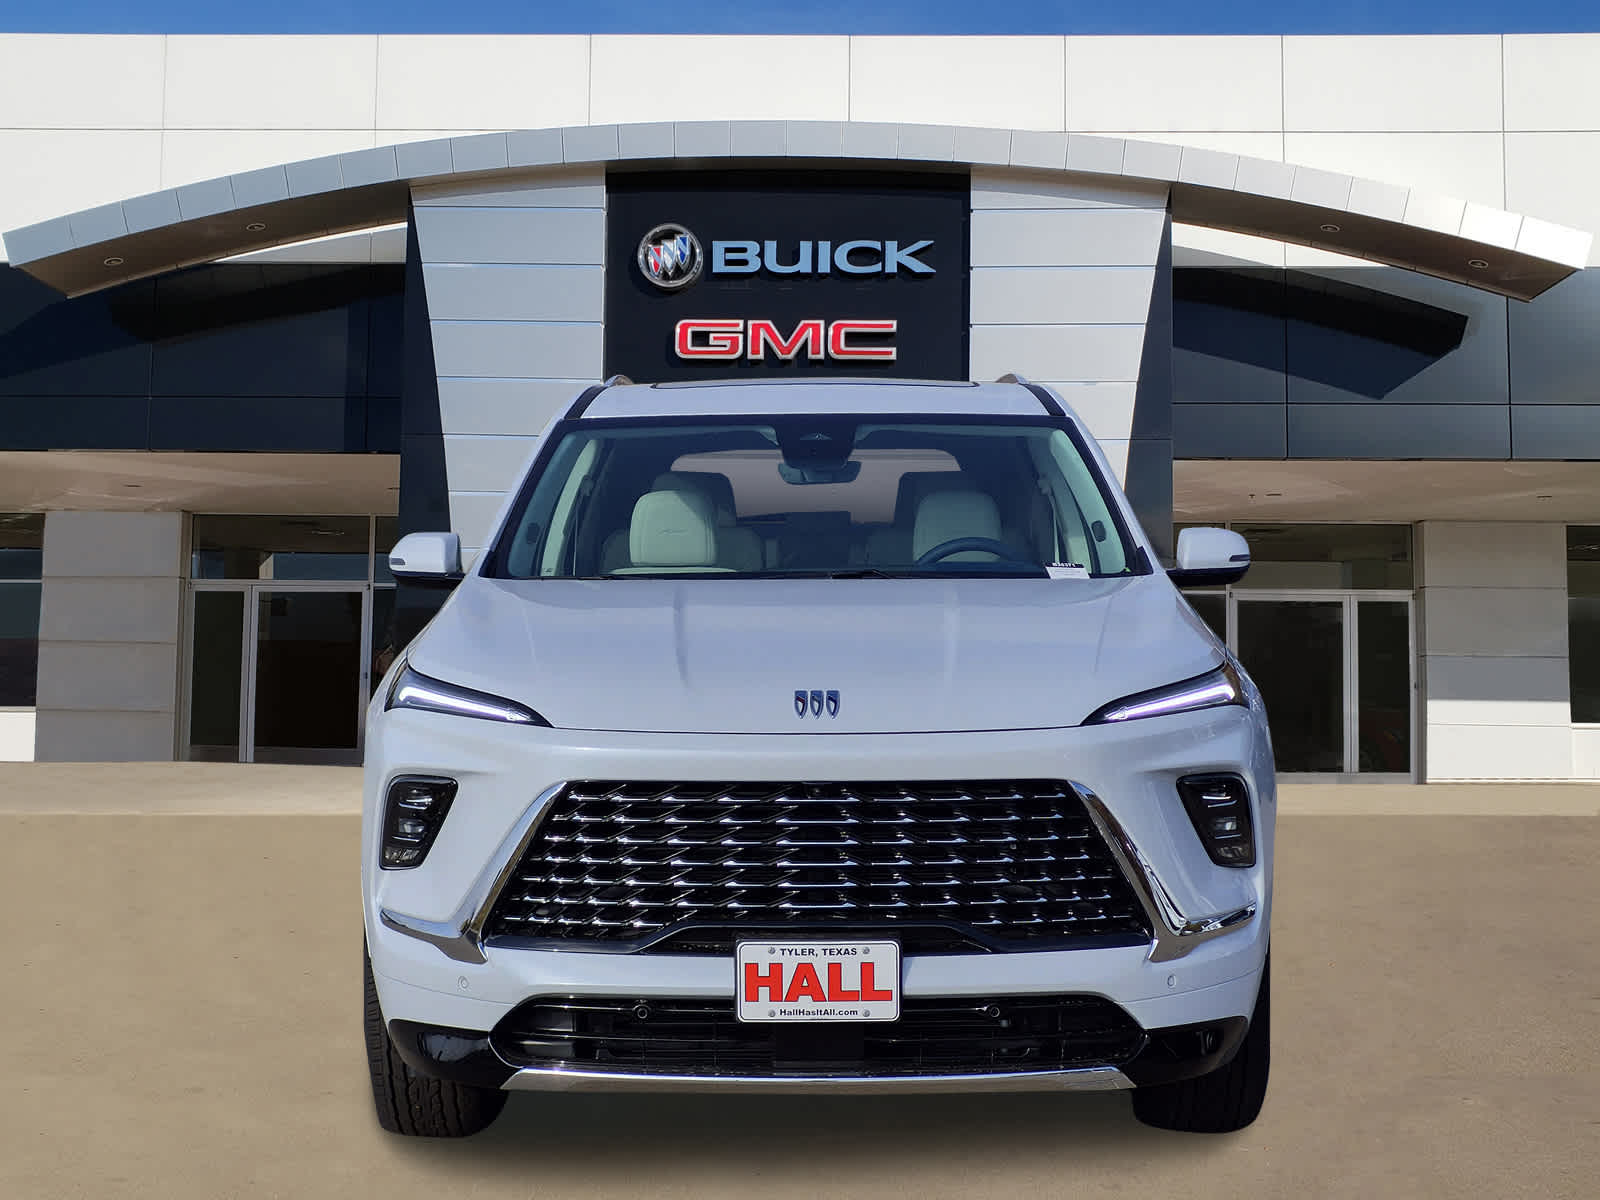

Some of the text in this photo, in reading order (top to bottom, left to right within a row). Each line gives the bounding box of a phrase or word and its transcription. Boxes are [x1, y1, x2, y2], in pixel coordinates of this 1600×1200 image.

[712, 240, 937, 273] BUICK
[675, 319, 897, 360] GMC
[780, 948, 857, 957] TYLER, TEXAS
[745, 962, 892, 1002] HALL
